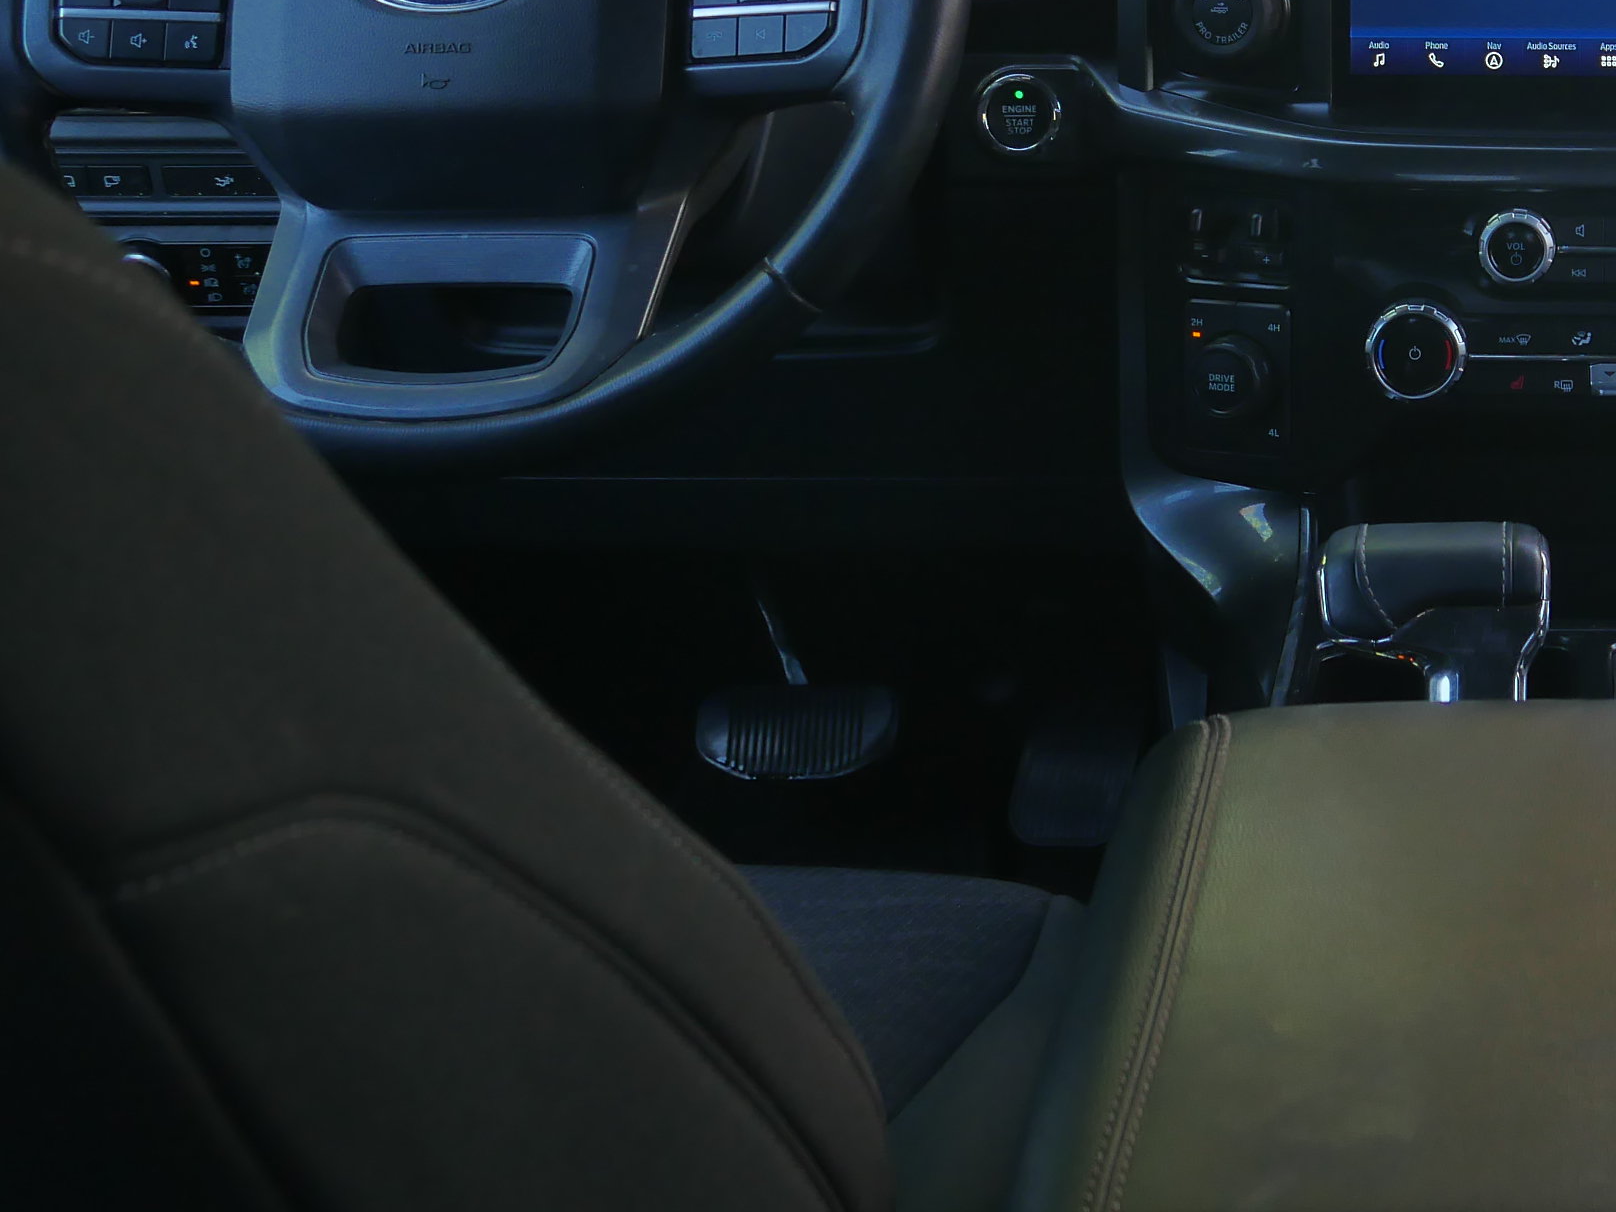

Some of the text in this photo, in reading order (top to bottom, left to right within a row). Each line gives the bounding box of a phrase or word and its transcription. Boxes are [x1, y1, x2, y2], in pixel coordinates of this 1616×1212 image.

[1195, 21, 1249, 44] PRO TRAILER
[404, 42, 473, 54] AIRBAG
[1368, 40, 1390, 50] Audio
[1424, 40, 1449, 50] Phone
[1486, 41, 1502, 50] Nav
[1526, 42, 1577, 51] Audio Sources
[1002, 104, 1037, 113] ENGINE
[1005, 118, 1034, 127] START
[1007, 127, 1033, 135] STOP
[1505, 242, 1526, 251] VOL
[1191, 317, 1204, 327] 2H
[1267, 323, 1281, 333] 4H
[1499, 336, 1516, 344] MAX
[1208, 373, 1236, 384] DRIVE
[1208, 382, 1236, 393] MODE
[1267, 428, 1280, 438] 4L
